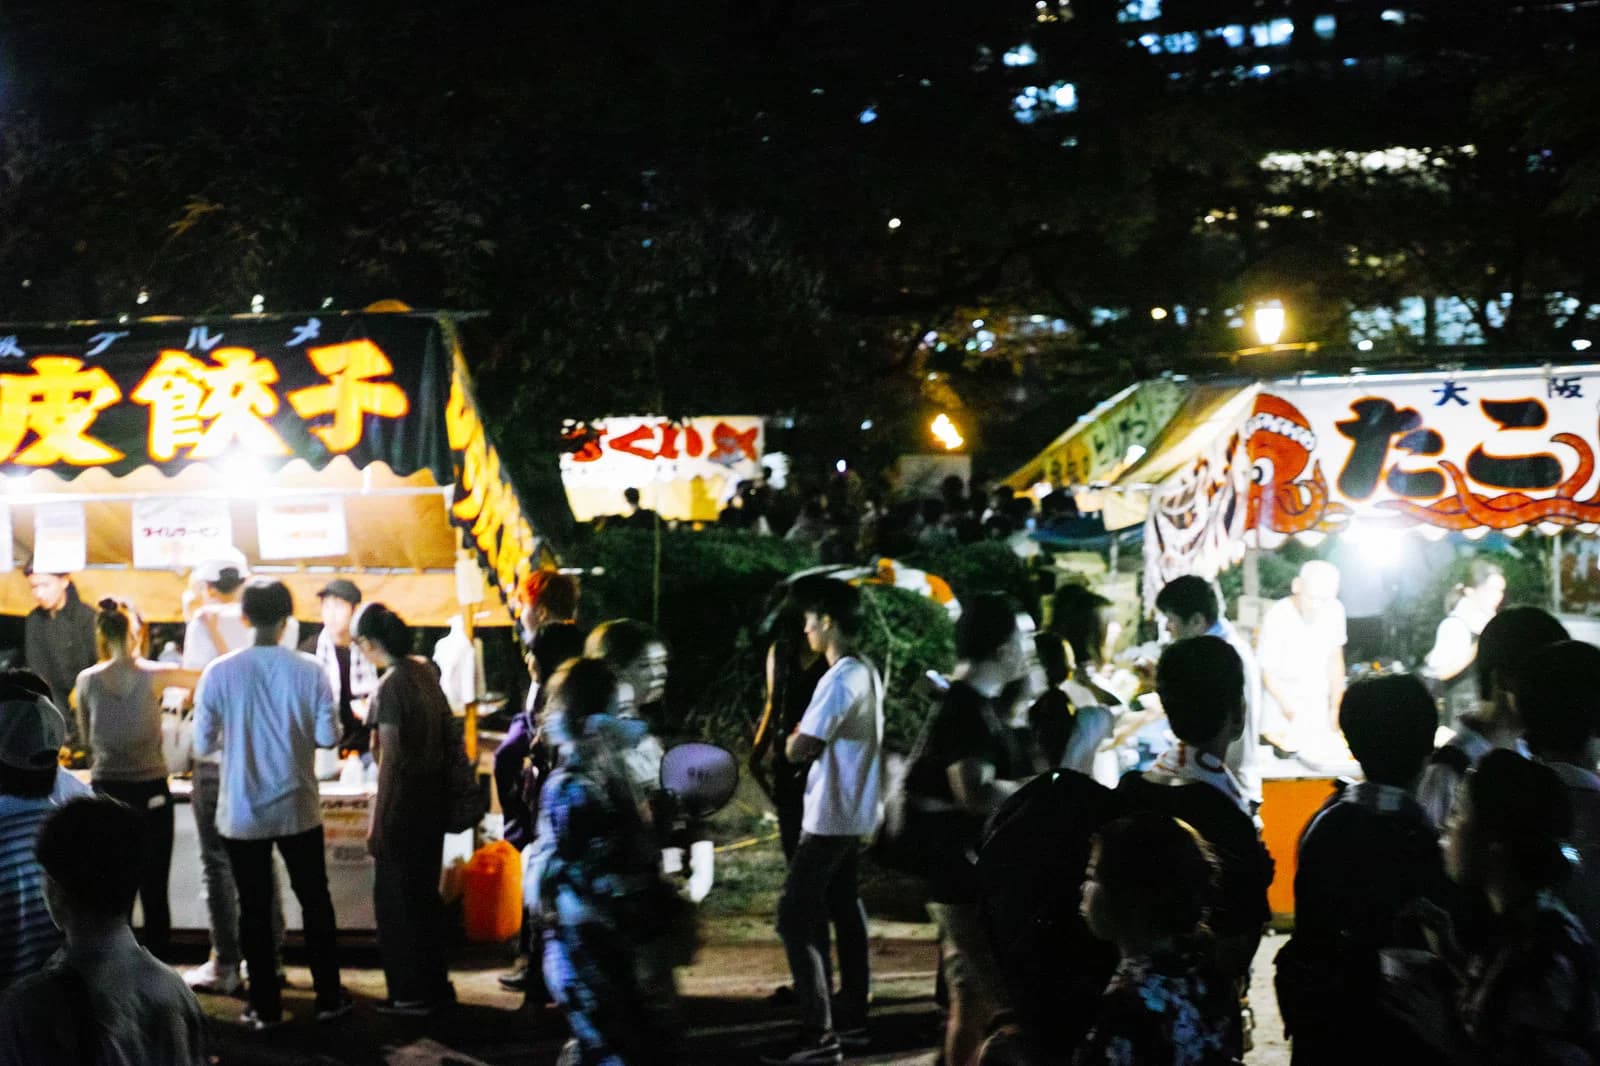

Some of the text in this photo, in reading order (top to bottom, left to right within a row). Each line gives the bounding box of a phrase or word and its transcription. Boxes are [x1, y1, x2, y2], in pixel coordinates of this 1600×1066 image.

[0, 338, 409, 466] 皮餃子
[1432, 376, 1584, 406] 大阪
[1334, 396, 1563, 500] たこ
